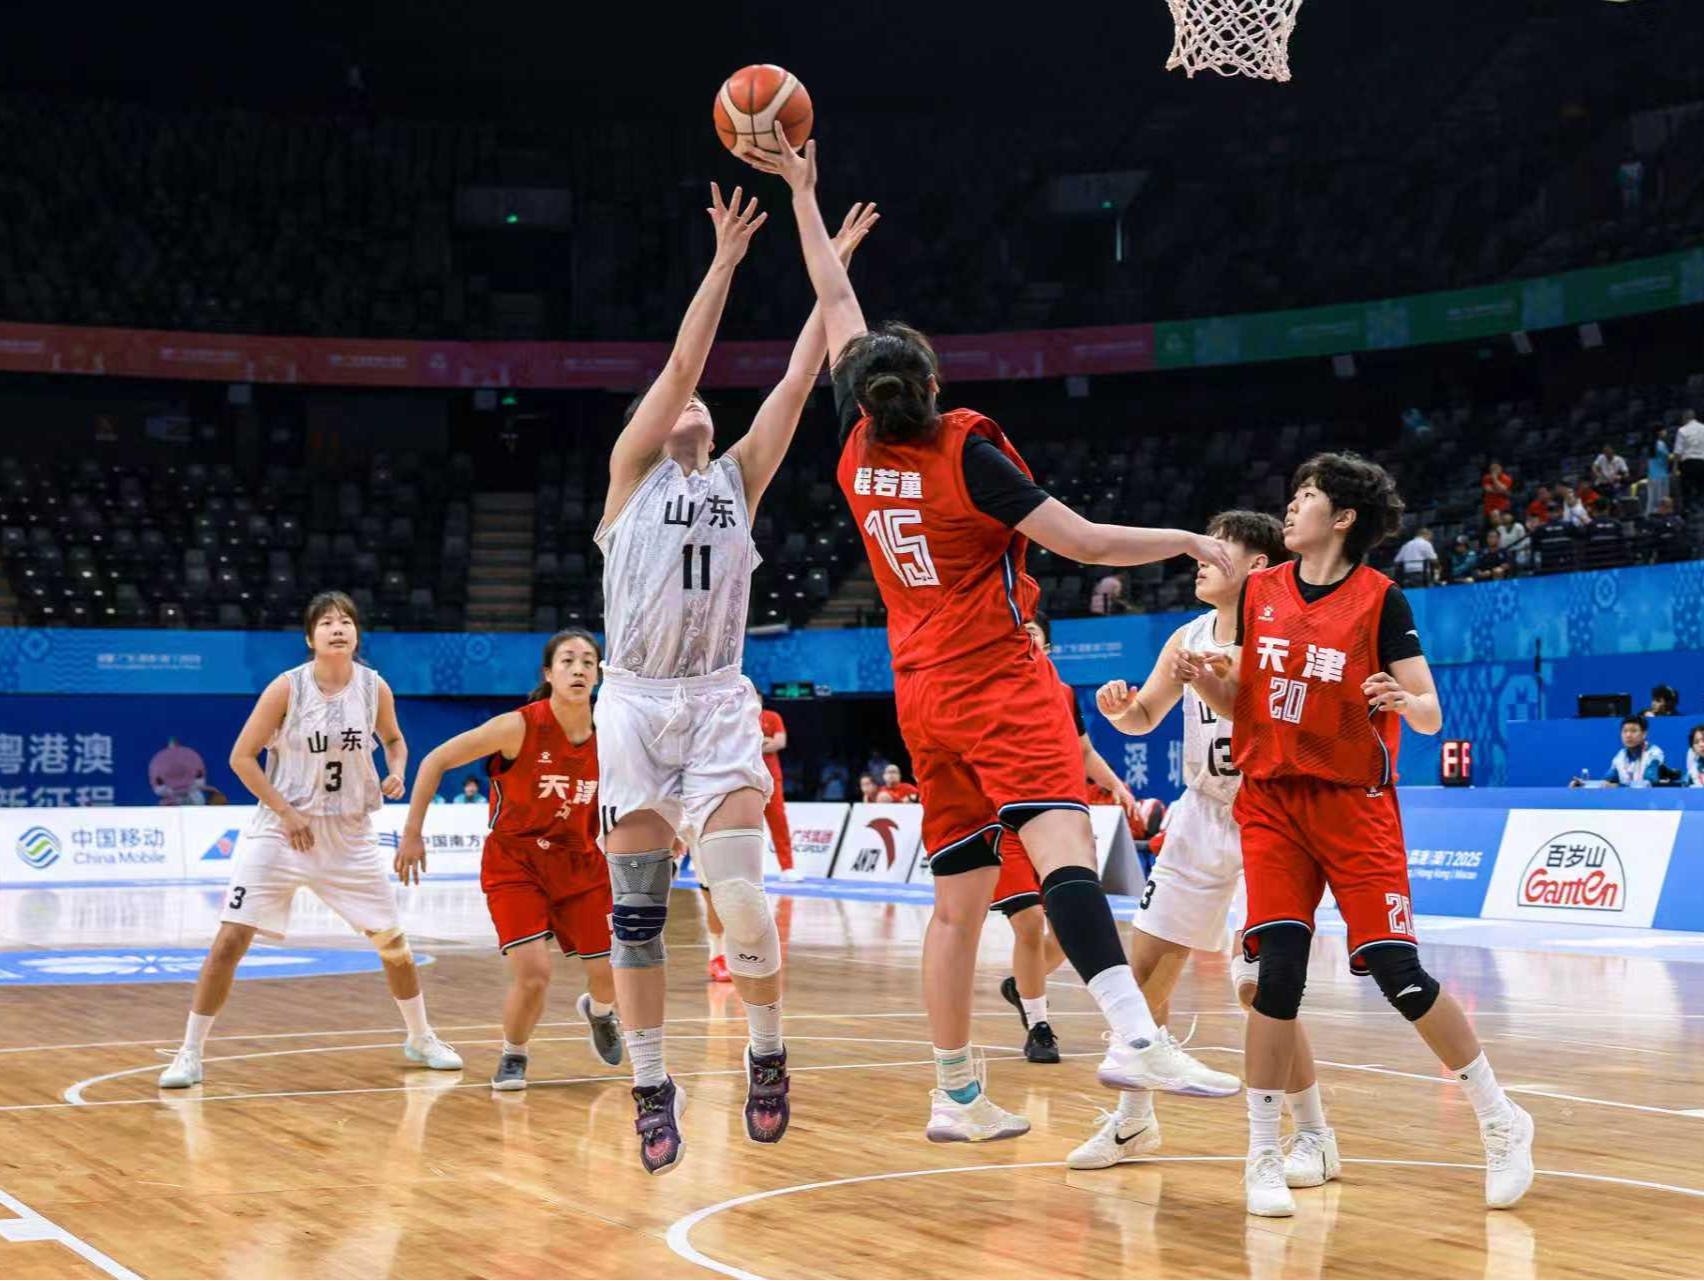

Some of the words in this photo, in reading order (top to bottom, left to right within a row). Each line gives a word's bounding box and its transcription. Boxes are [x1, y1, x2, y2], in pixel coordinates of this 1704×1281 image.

[664, 494, 736, 528] 山东
[863, 509, 941, 587] 15
[682, 544, 711, 590] 11
[1257, 636, 1347, 683] 天津
[1268, 676, 1308, 724] 20
[307, 728, 362, 753] 山东
[325, 761, 342, 792] 3
[538, 775, 599, 805] 天津
[72, 828, 165, 848] 中国移动
[73, 852, 117, 864] China
[119, 852, 166, 864] Mobile
[1546, 845, 1606, 867] 百岁山
[229, 886, 246, 909] 3
[1140, 880, 1156, 910] 3
